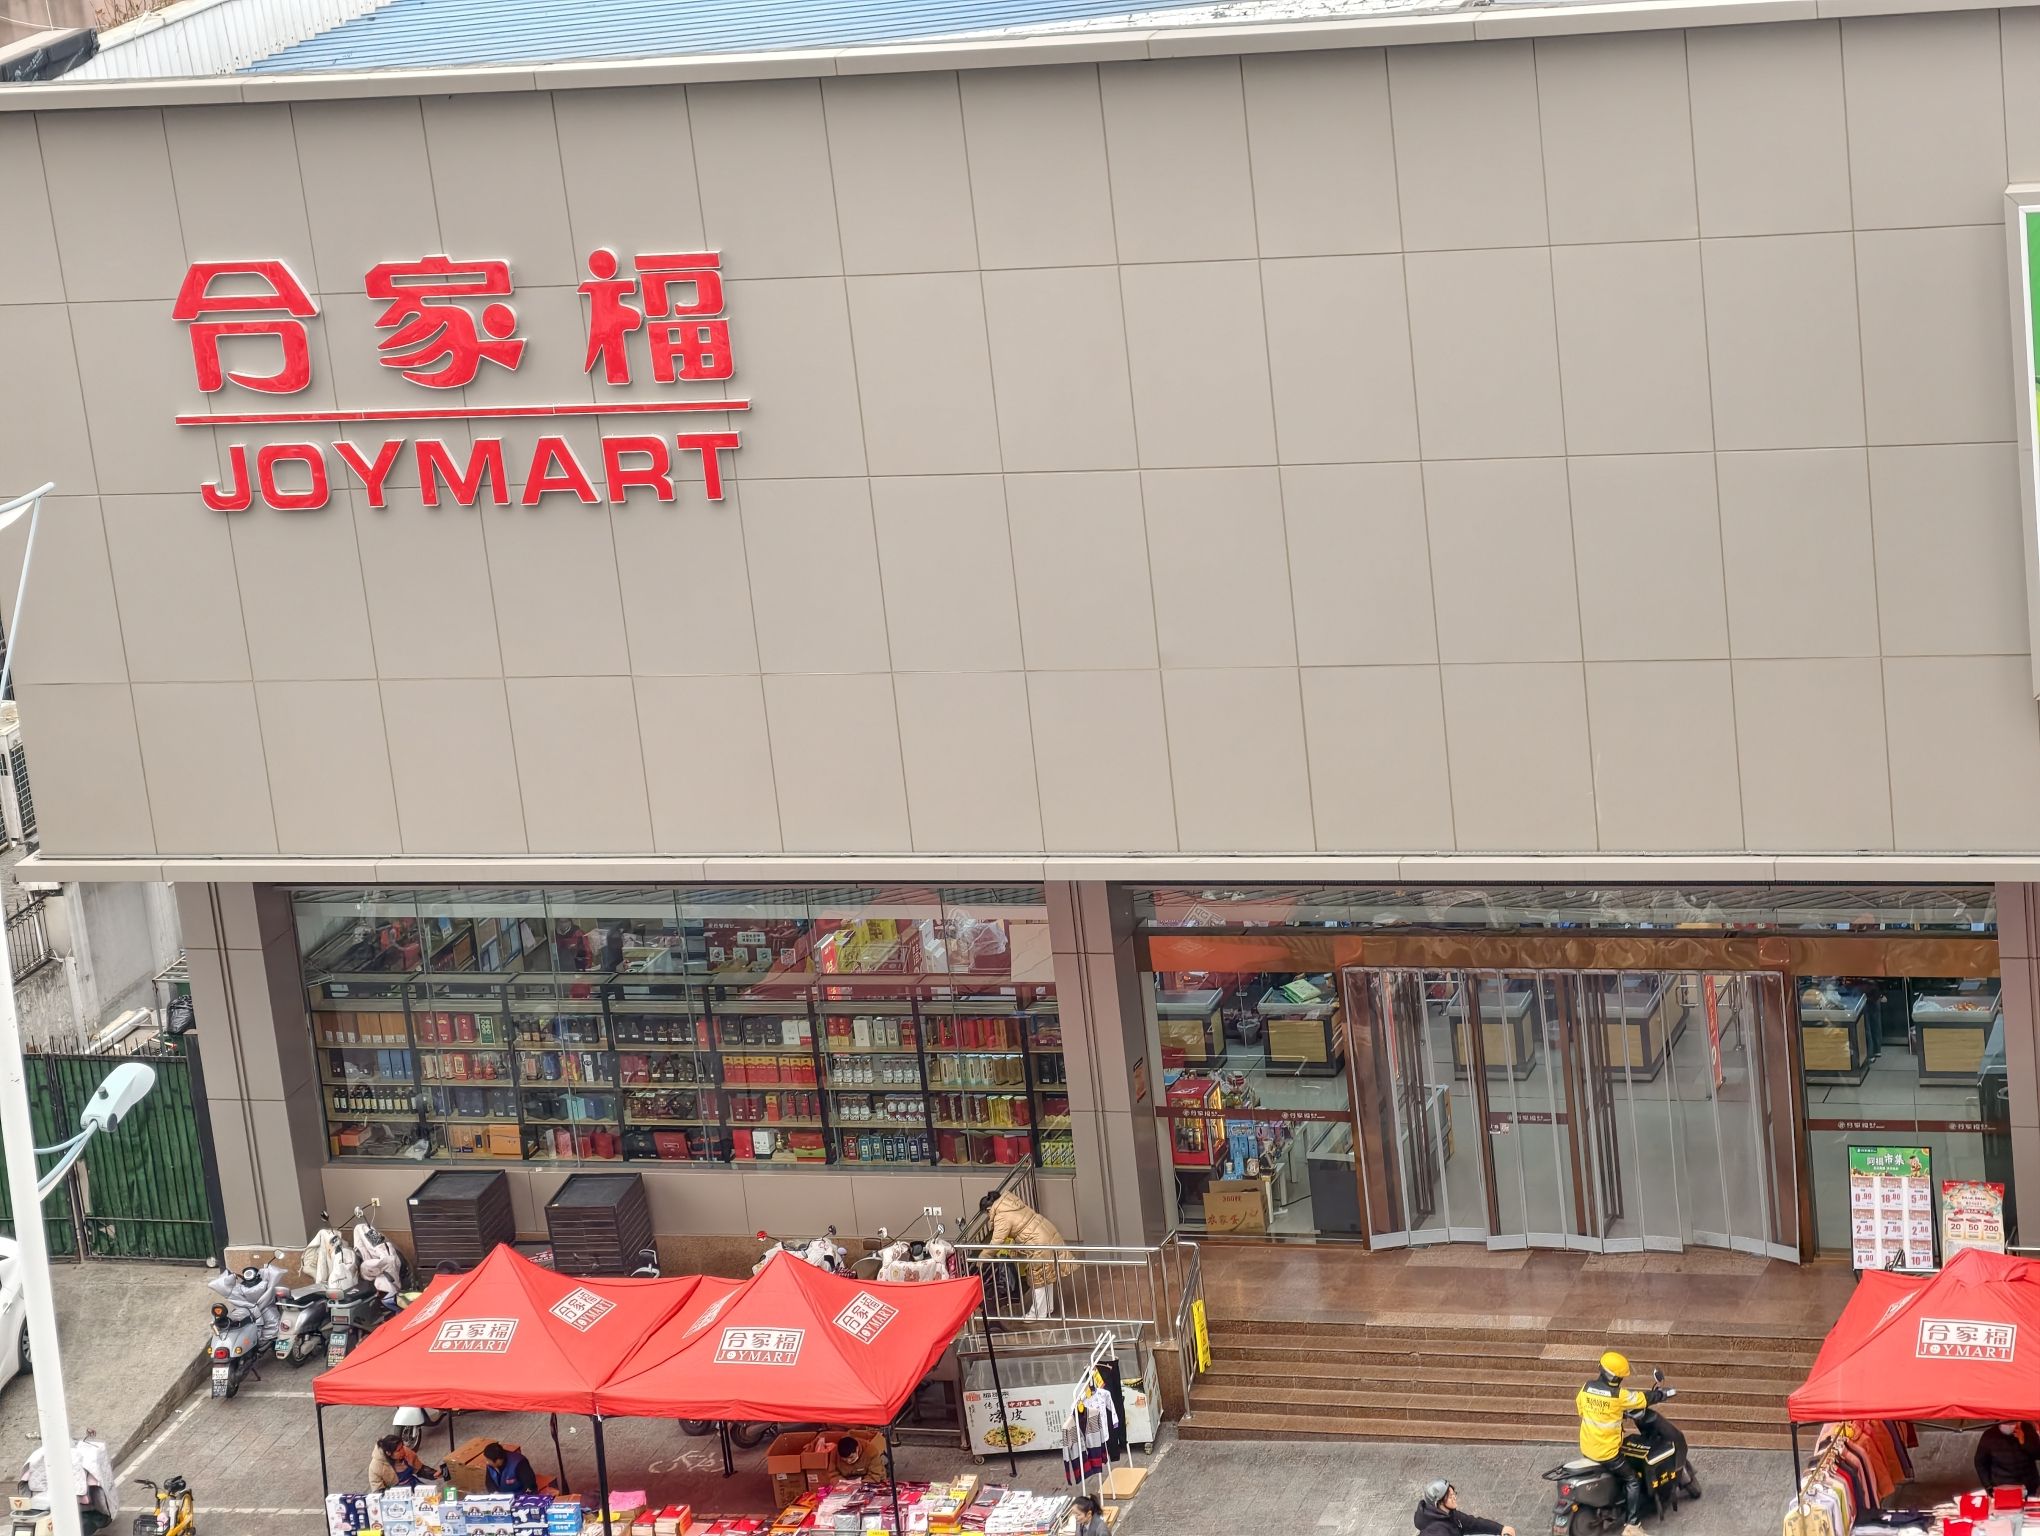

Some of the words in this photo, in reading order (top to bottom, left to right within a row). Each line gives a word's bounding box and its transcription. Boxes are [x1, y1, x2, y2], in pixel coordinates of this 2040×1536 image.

[172, 247, 736, 394] 合家福
[200, 431, 742, 512] JOYMART
[573, 1298, 612, 1330] JOYMART
[842, 1296, 880, 1330] 合家福
[857, 1304, 895, 1342] JOYMART
[444, 1323, 510, 1339] 合家福
[728, 1332, 799, 1349] 合家福
[1927, 1324, 2009, 1345] 合家福
[433, 1339, 507, 1351] JOYMART
[1920, 1343, 2010, 1359] JOYMART
[718, 1350, 795, 1363] JOYMART
